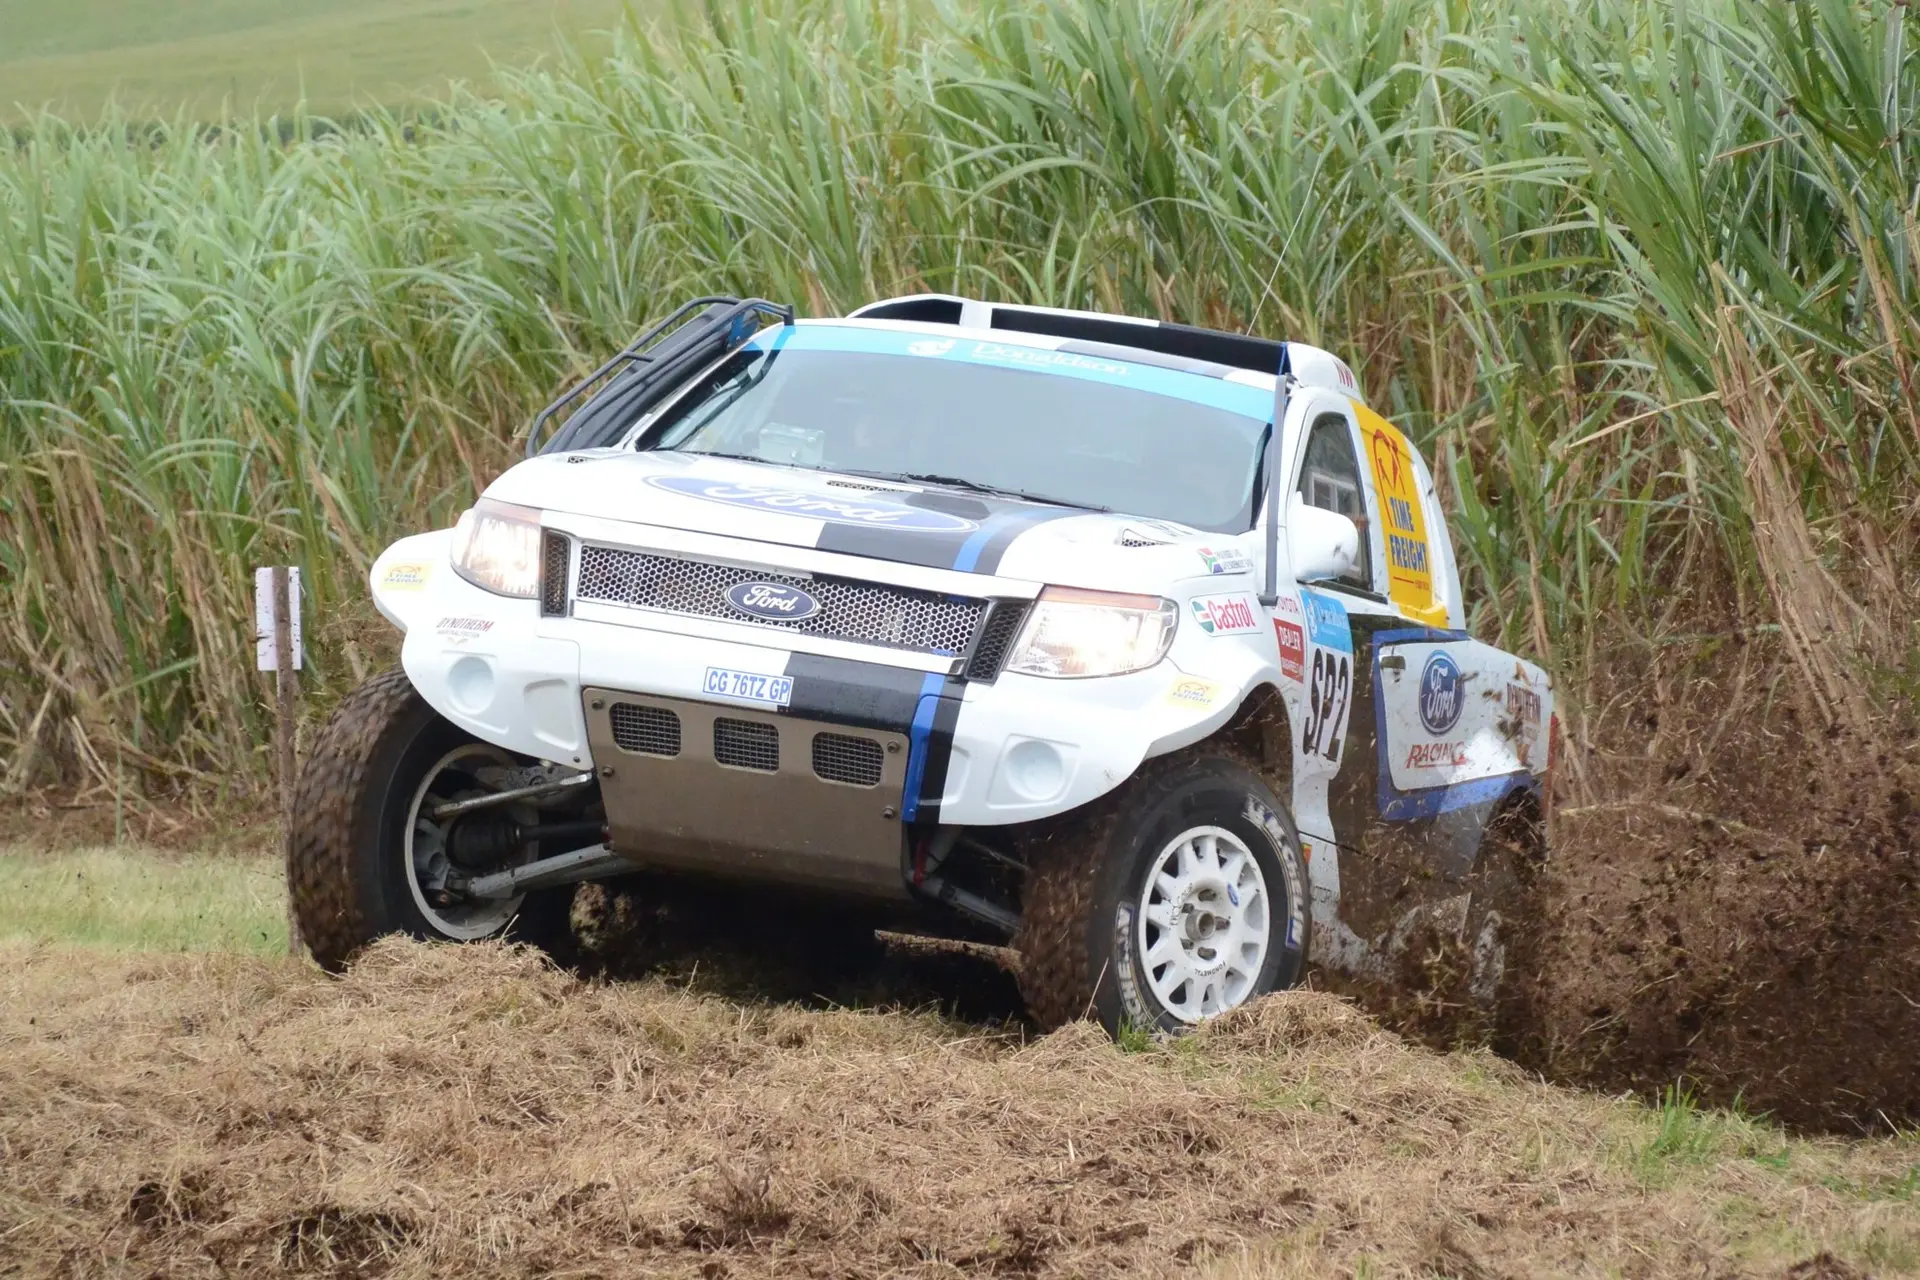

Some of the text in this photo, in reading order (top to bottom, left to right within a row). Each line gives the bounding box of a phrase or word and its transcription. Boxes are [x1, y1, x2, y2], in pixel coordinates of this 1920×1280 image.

[703, 484, 915, 522] Ford
[1390, 496, 1414, 532] TIME
[1389, 534, 1428, 573] FREIGHT
[742, 584, 799, 613] Ford
[1208, 597, 1256, 631] Castrol
[708, 670, 790, 702] CG 76TZ GP
[1427, 664, 1456, 720] Ford
[1302, 647, 1349, 762] SP2
[1405, 741, 1467, 768] RACING
